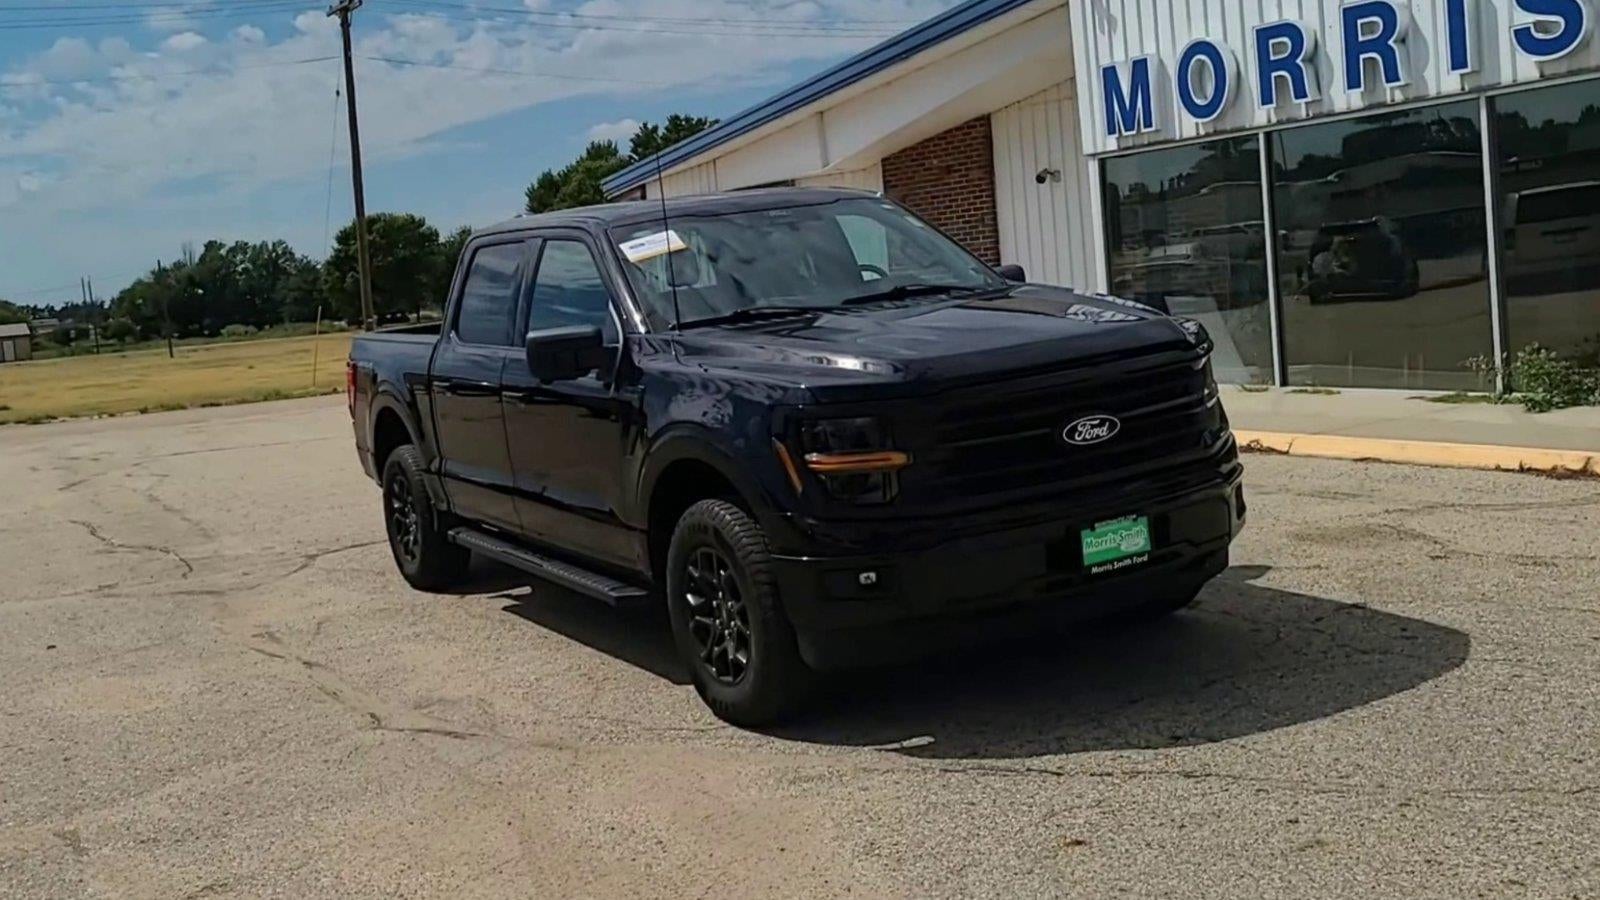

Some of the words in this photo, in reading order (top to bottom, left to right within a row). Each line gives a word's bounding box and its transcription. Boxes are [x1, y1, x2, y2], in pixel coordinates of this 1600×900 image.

[1101, 0, 1585, 137] MORRIS
[1075, 419, 1109, 440] Ford
[1084, 534, 1117, 551] Morris
[1118, 526, 1146, 543] Smith
[1091, 563, 1113, 574] Morris
[1113, 559, 1132, 569] Smith
[1133, 553, 1148, 564] Ford
